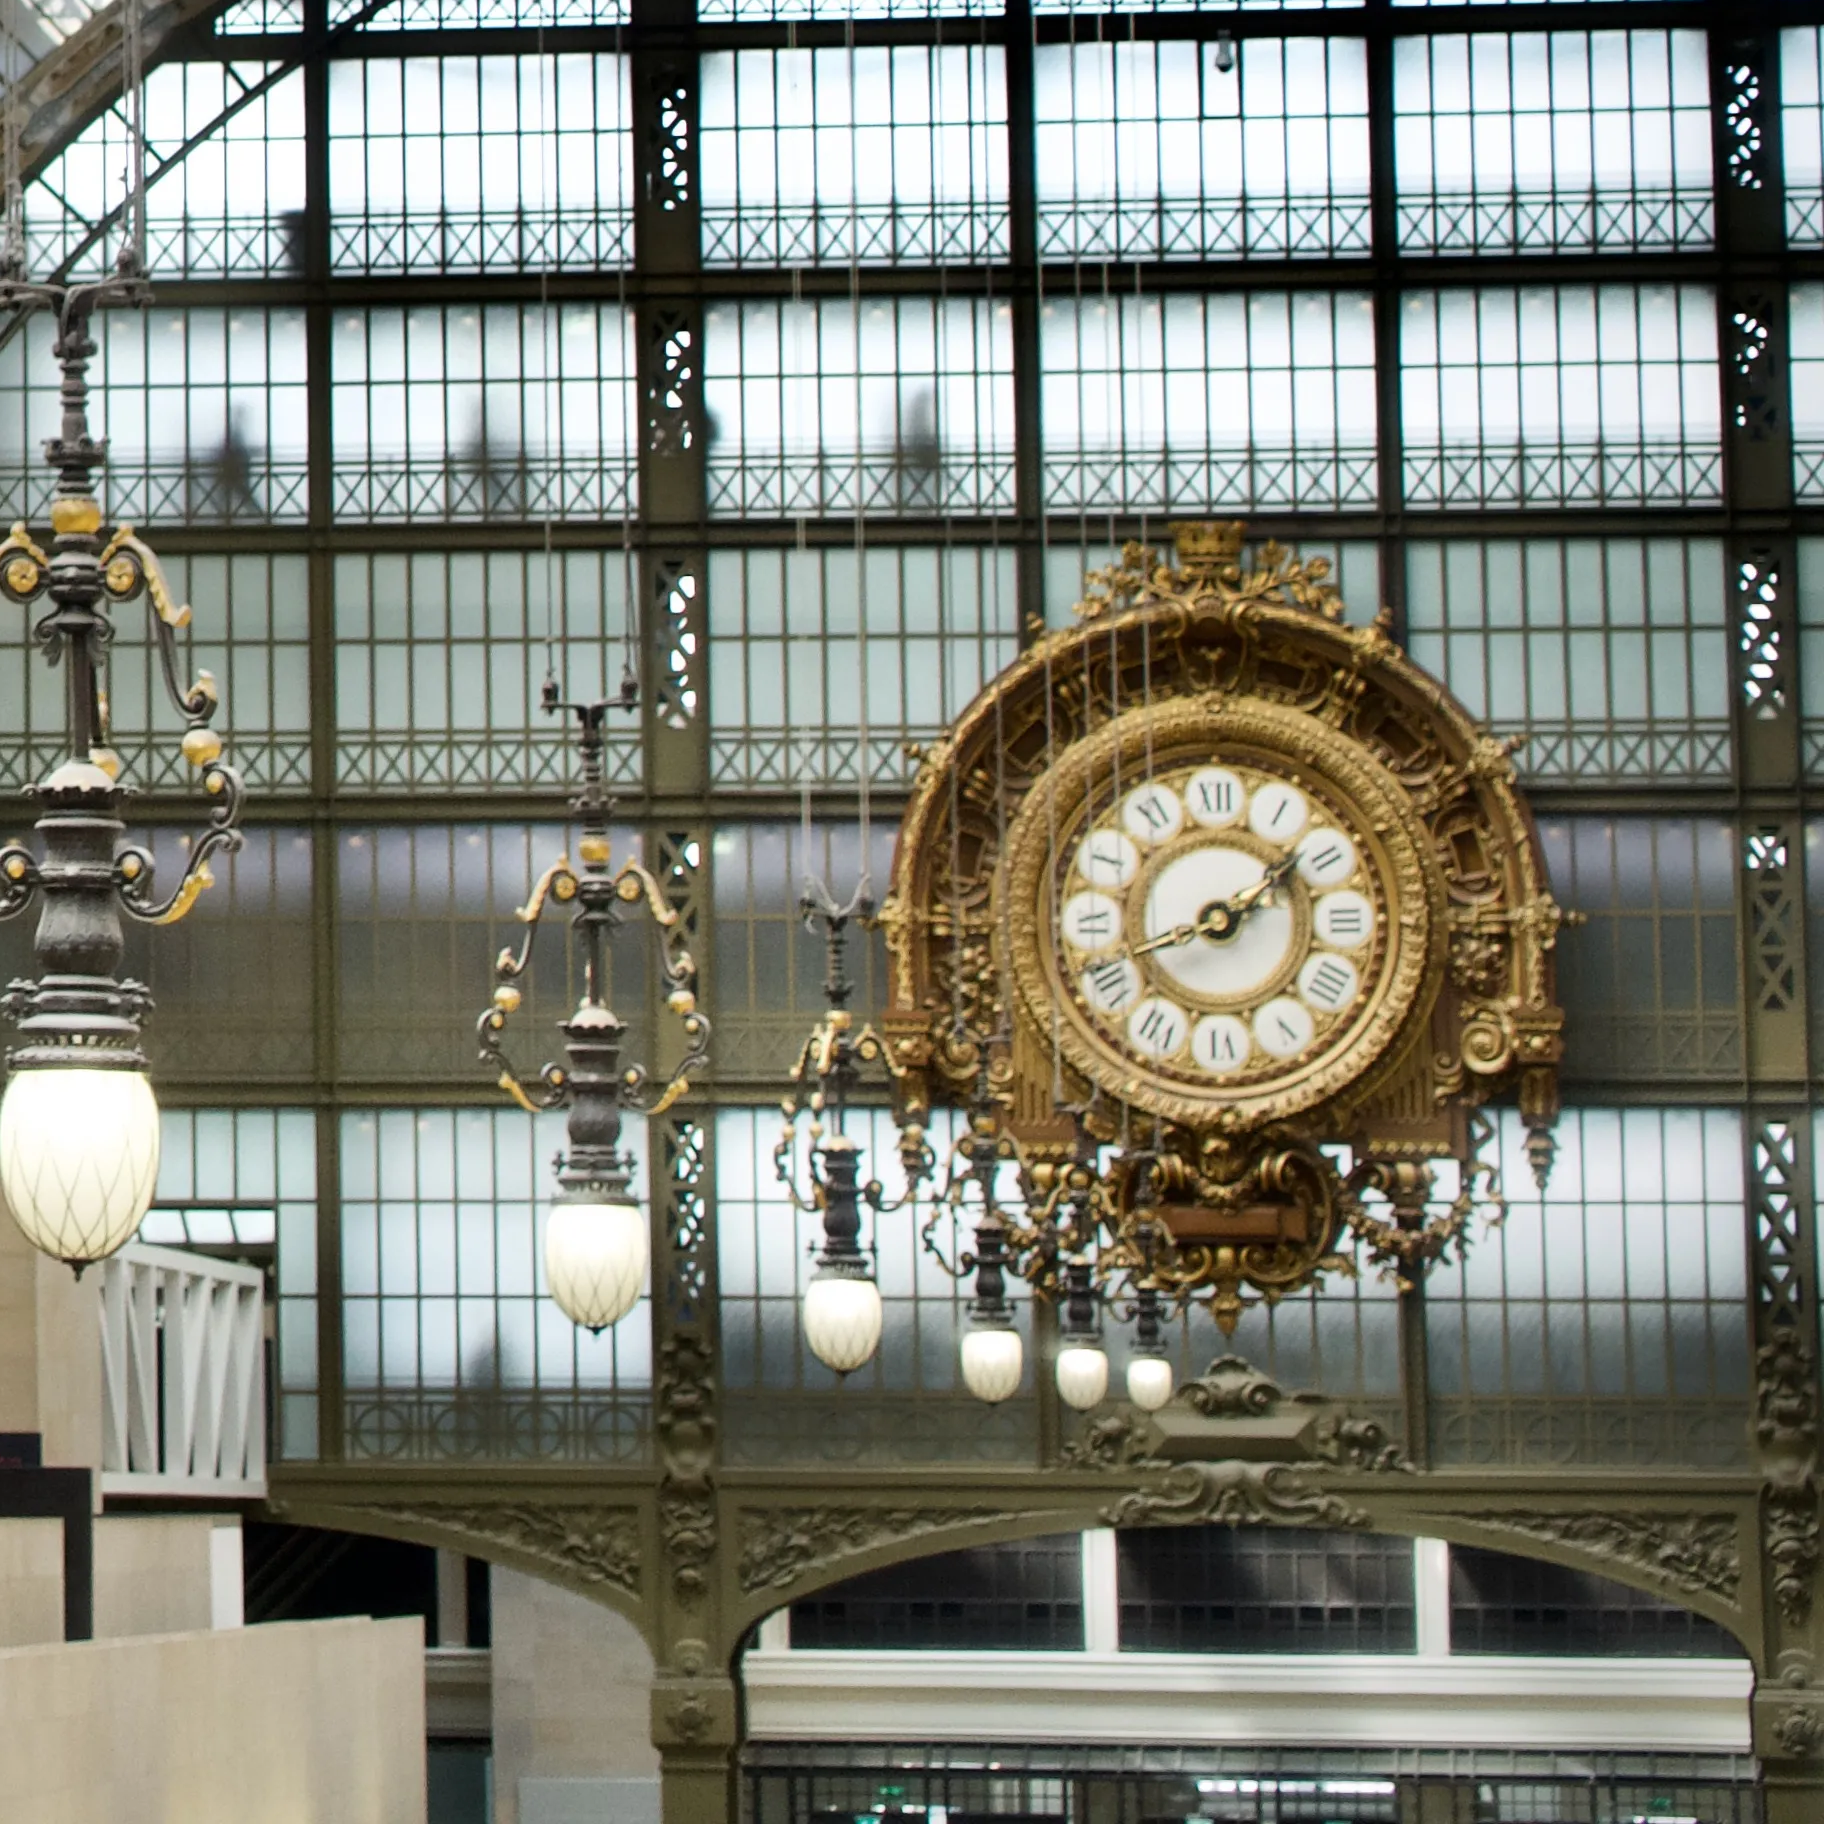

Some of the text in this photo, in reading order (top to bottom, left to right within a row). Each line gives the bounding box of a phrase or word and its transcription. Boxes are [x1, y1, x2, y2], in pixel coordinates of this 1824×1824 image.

[1136, 796, 1169, 829] XI
[1199, 782, 1231, 813] XII
[1271, 799, 1288, 826] I
[1311, 845, 1343, 872] II
[1078, 911, 1109, 933] IX
[1329, 908, 1361, 933] III
[1308, 961, 1351, 1004] IIII
[1139, 1008, 1175, 1050] VII
[1211, 1029, 1236, 1060] VI
[1276, 1016, 1299, 1047] V
